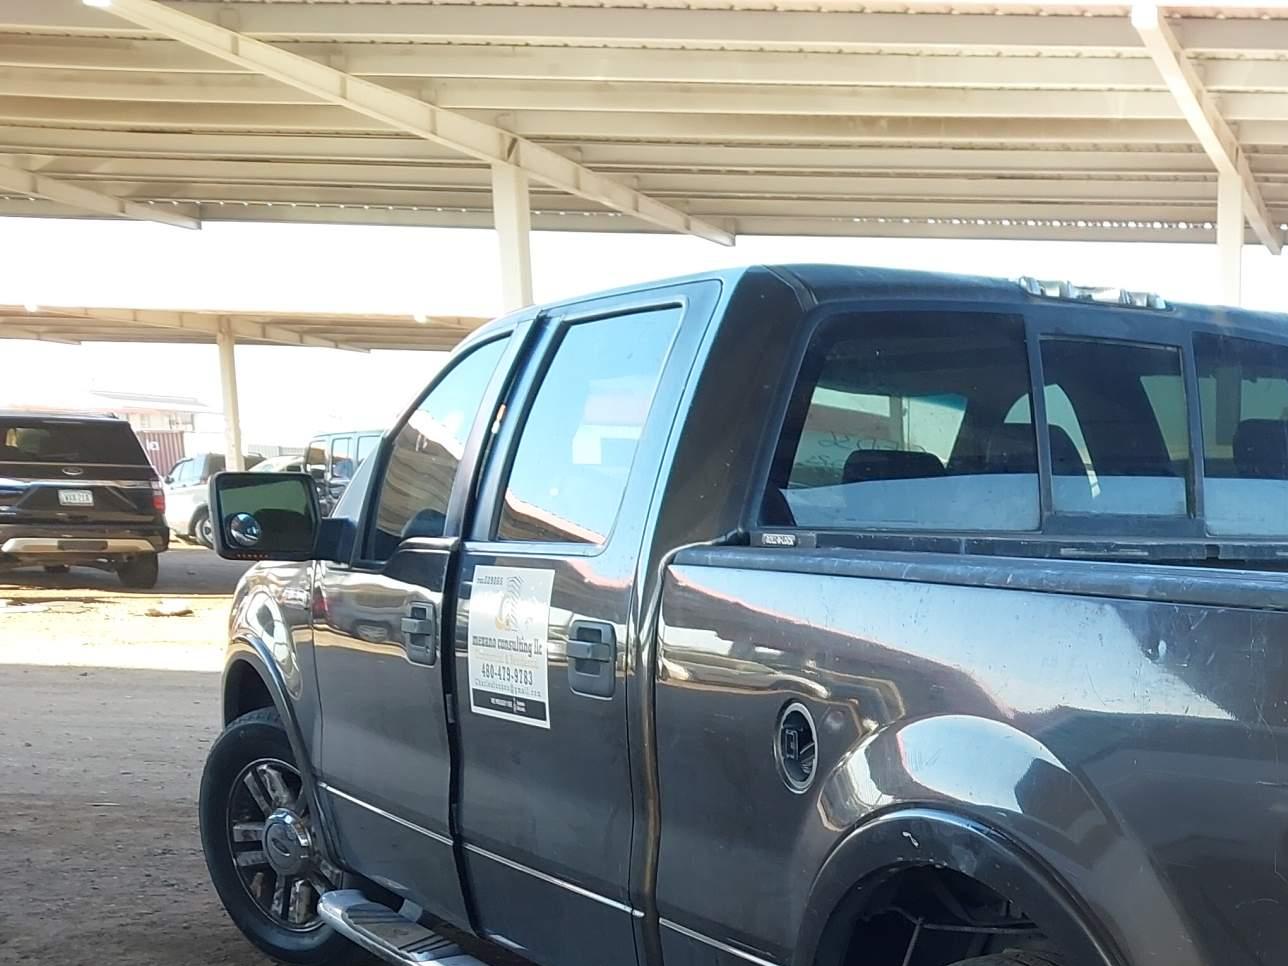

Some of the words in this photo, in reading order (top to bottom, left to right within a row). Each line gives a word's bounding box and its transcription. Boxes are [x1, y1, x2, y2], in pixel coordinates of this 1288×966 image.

[497, 635, 533, 658] consulting
[533, 638, 543, 655] llc
[481, 663, 533, 686] 480-479-9783
